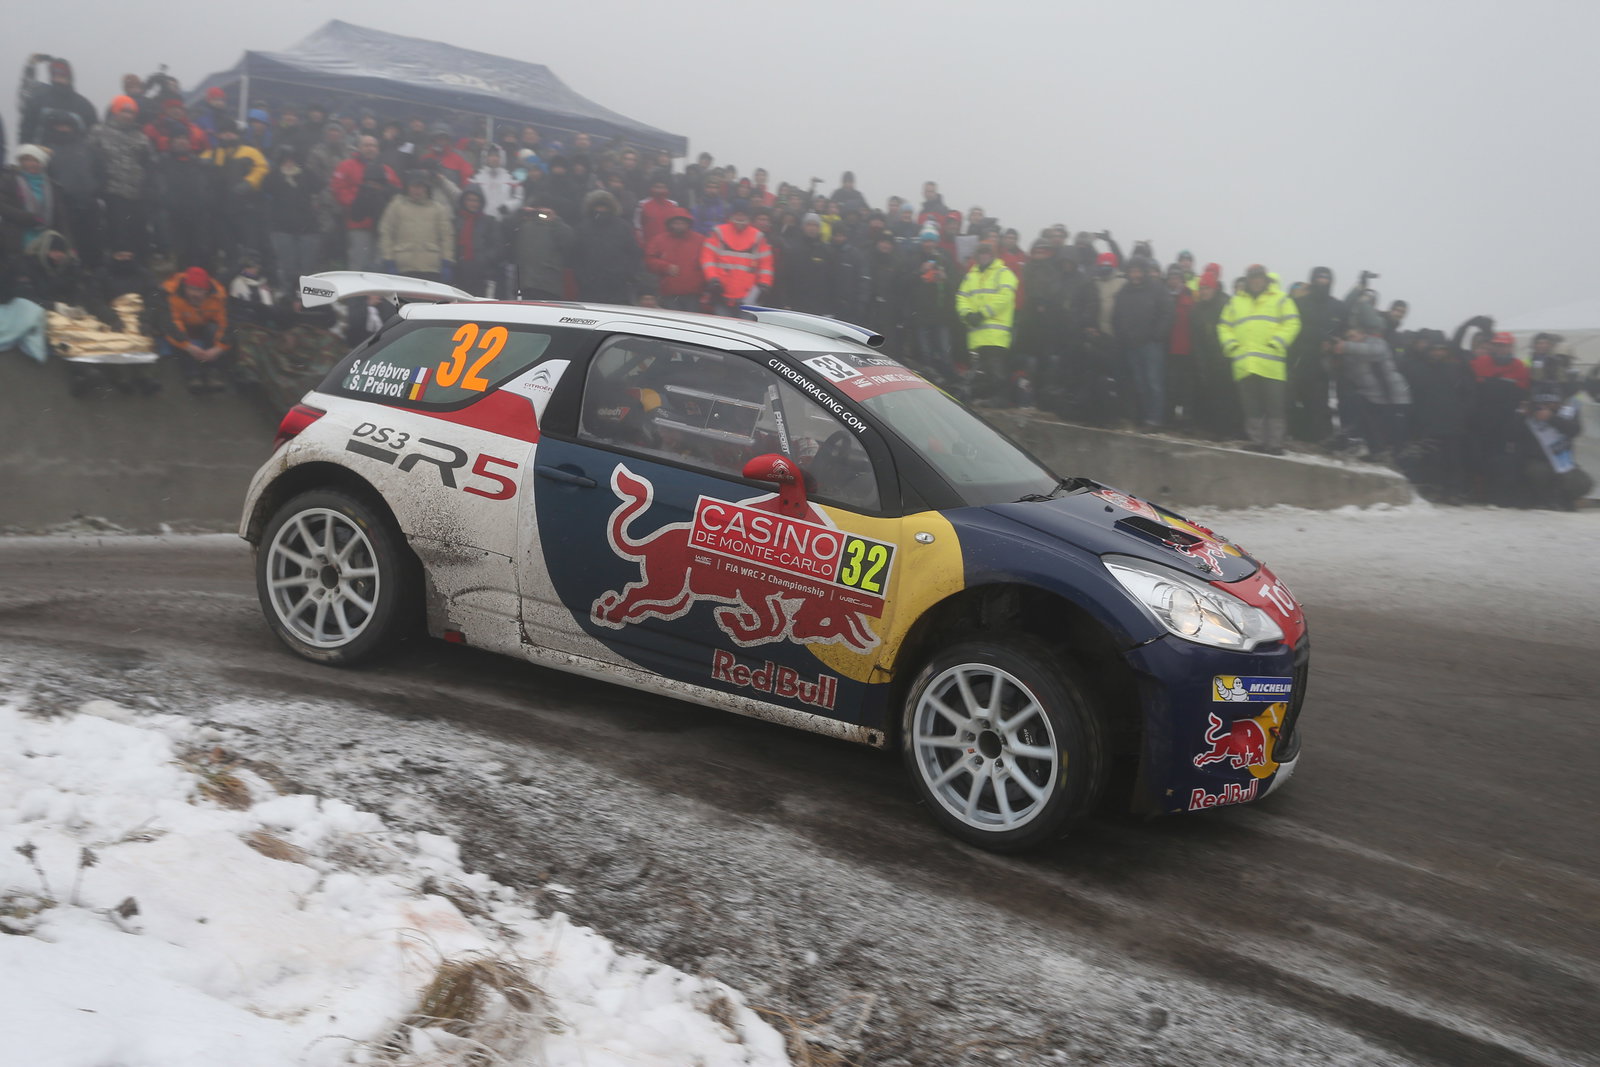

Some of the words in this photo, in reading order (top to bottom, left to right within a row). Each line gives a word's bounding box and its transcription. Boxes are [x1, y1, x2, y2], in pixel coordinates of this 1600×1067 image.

[350, 359, 361, 373] S.
[362, 360, 411, 380] Lefebvre
[435, 322, 509, 392] 32
[811, 355, 854, 379] 32
[349, 374, 360, 390] S.
[363, 376, 404, 397] Prévot
[768, 358, 867, 433] CITROENRACING.COM
[352, 422, 410, 449] DS3
[397, 437, 519, 500] R5
[700, 504, 838, 561] CASINO
[695, 530, 716, 545] DE
[719, 536, 833, 577] MONTE-CARLO
[841, 539, 888, 593] 32
[725, 563, 739, 573] FIA
[740, 567, 760, 578] WRC
[760, 572, 766, 580] 2
[768, 574, 825, 598] Championship
[1249, 683, 1291, 693] MICHELIN
